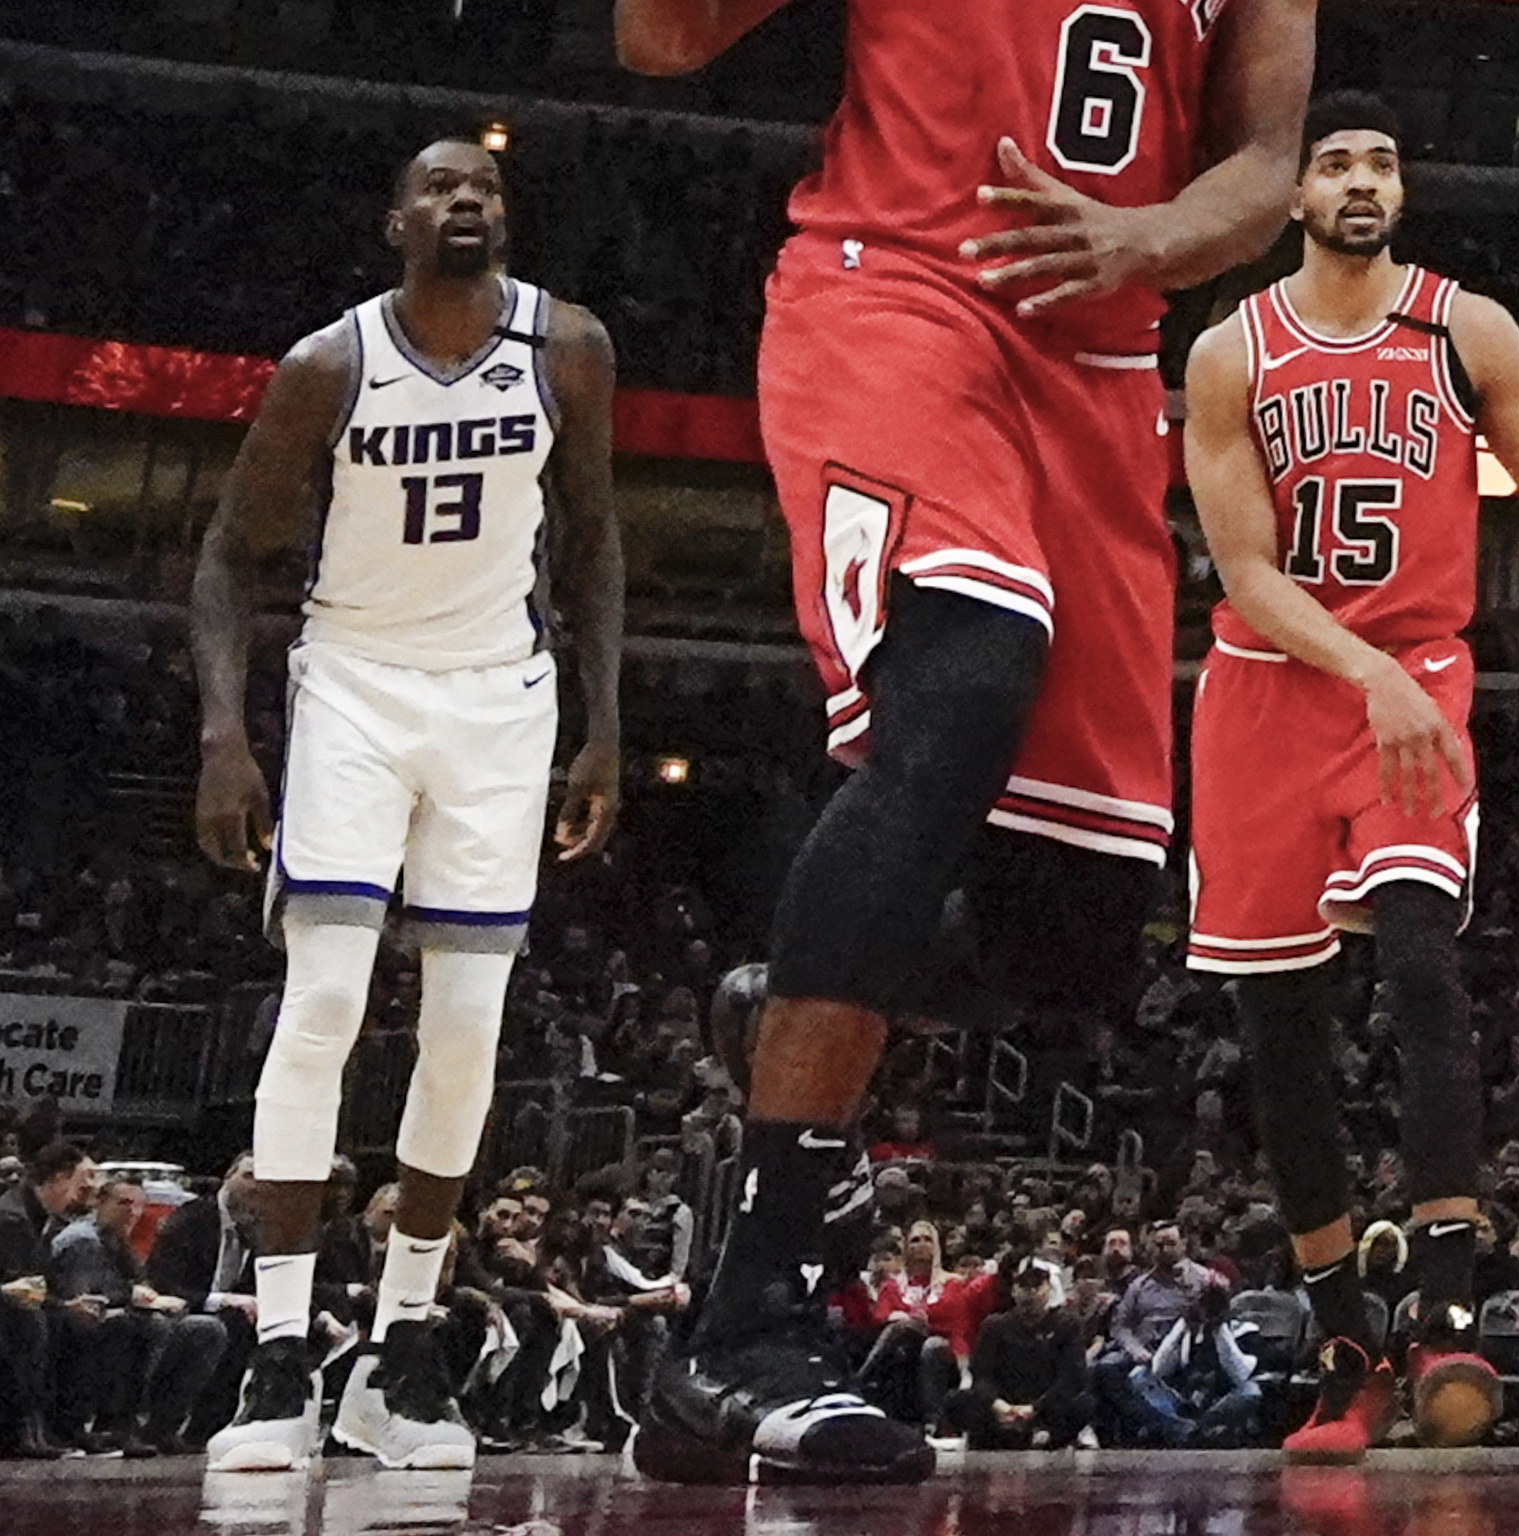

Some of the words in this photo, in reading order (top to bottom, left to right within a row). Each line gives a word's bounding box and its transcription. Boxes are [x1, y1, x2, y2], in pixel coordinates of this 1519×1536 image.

[1045, 3, 1153, 175] 6
[349, 414, 537, 467] KINGS
[1254, 378, 1441, 485] BULLS
[400, 472, 484, 545] 13
[1285, 476, 1402, 586] 15
[0, 1019, 79, 1052] cate
[23, 1063, 104, 1099] Care
